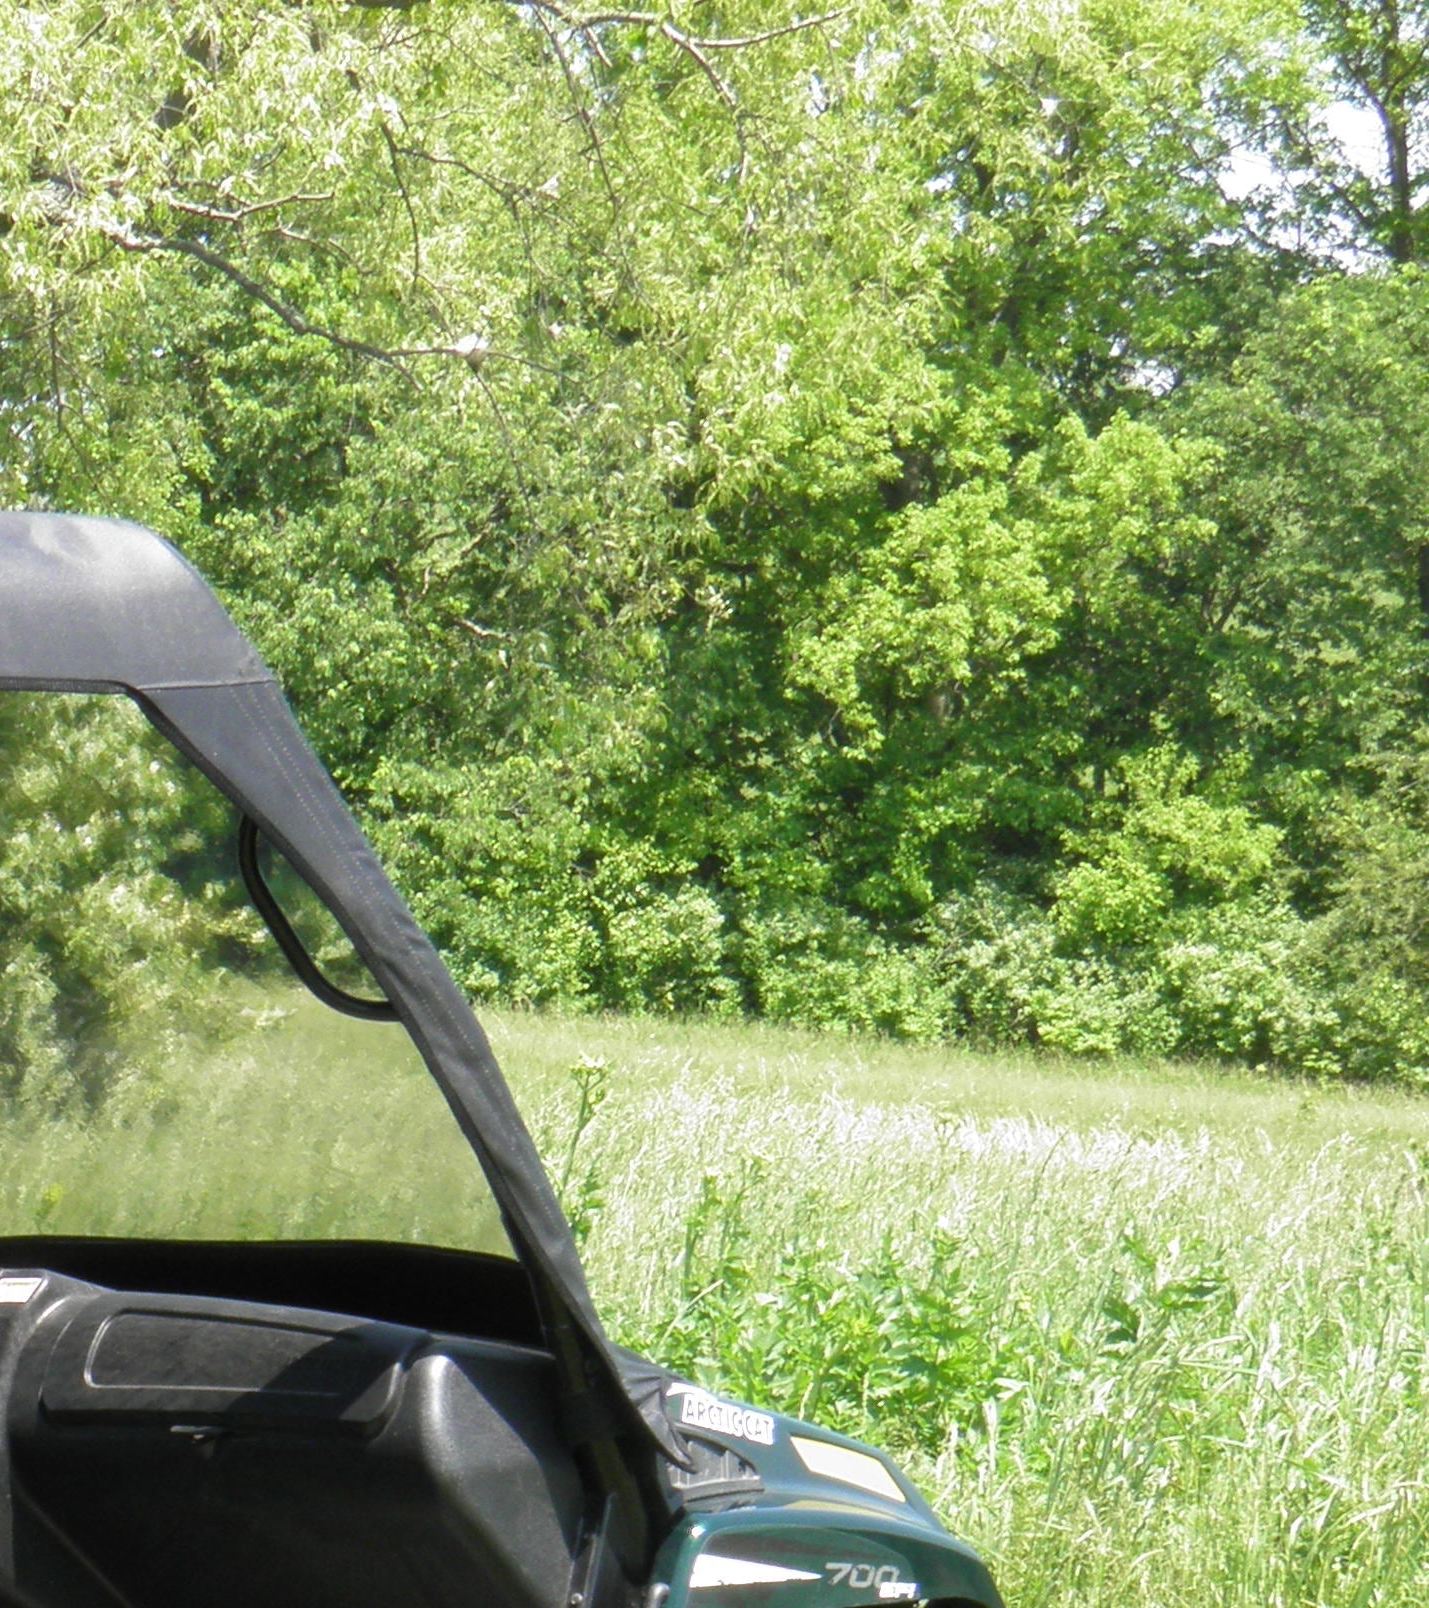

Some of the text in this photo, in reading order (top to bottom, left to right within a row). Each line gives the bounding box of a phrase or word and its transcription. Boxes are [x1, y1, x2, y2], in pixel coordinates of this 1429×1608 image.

[683, 1396, 774, 1444] ARCTIC CAT
[825, 1562, 900, 1589] 700
